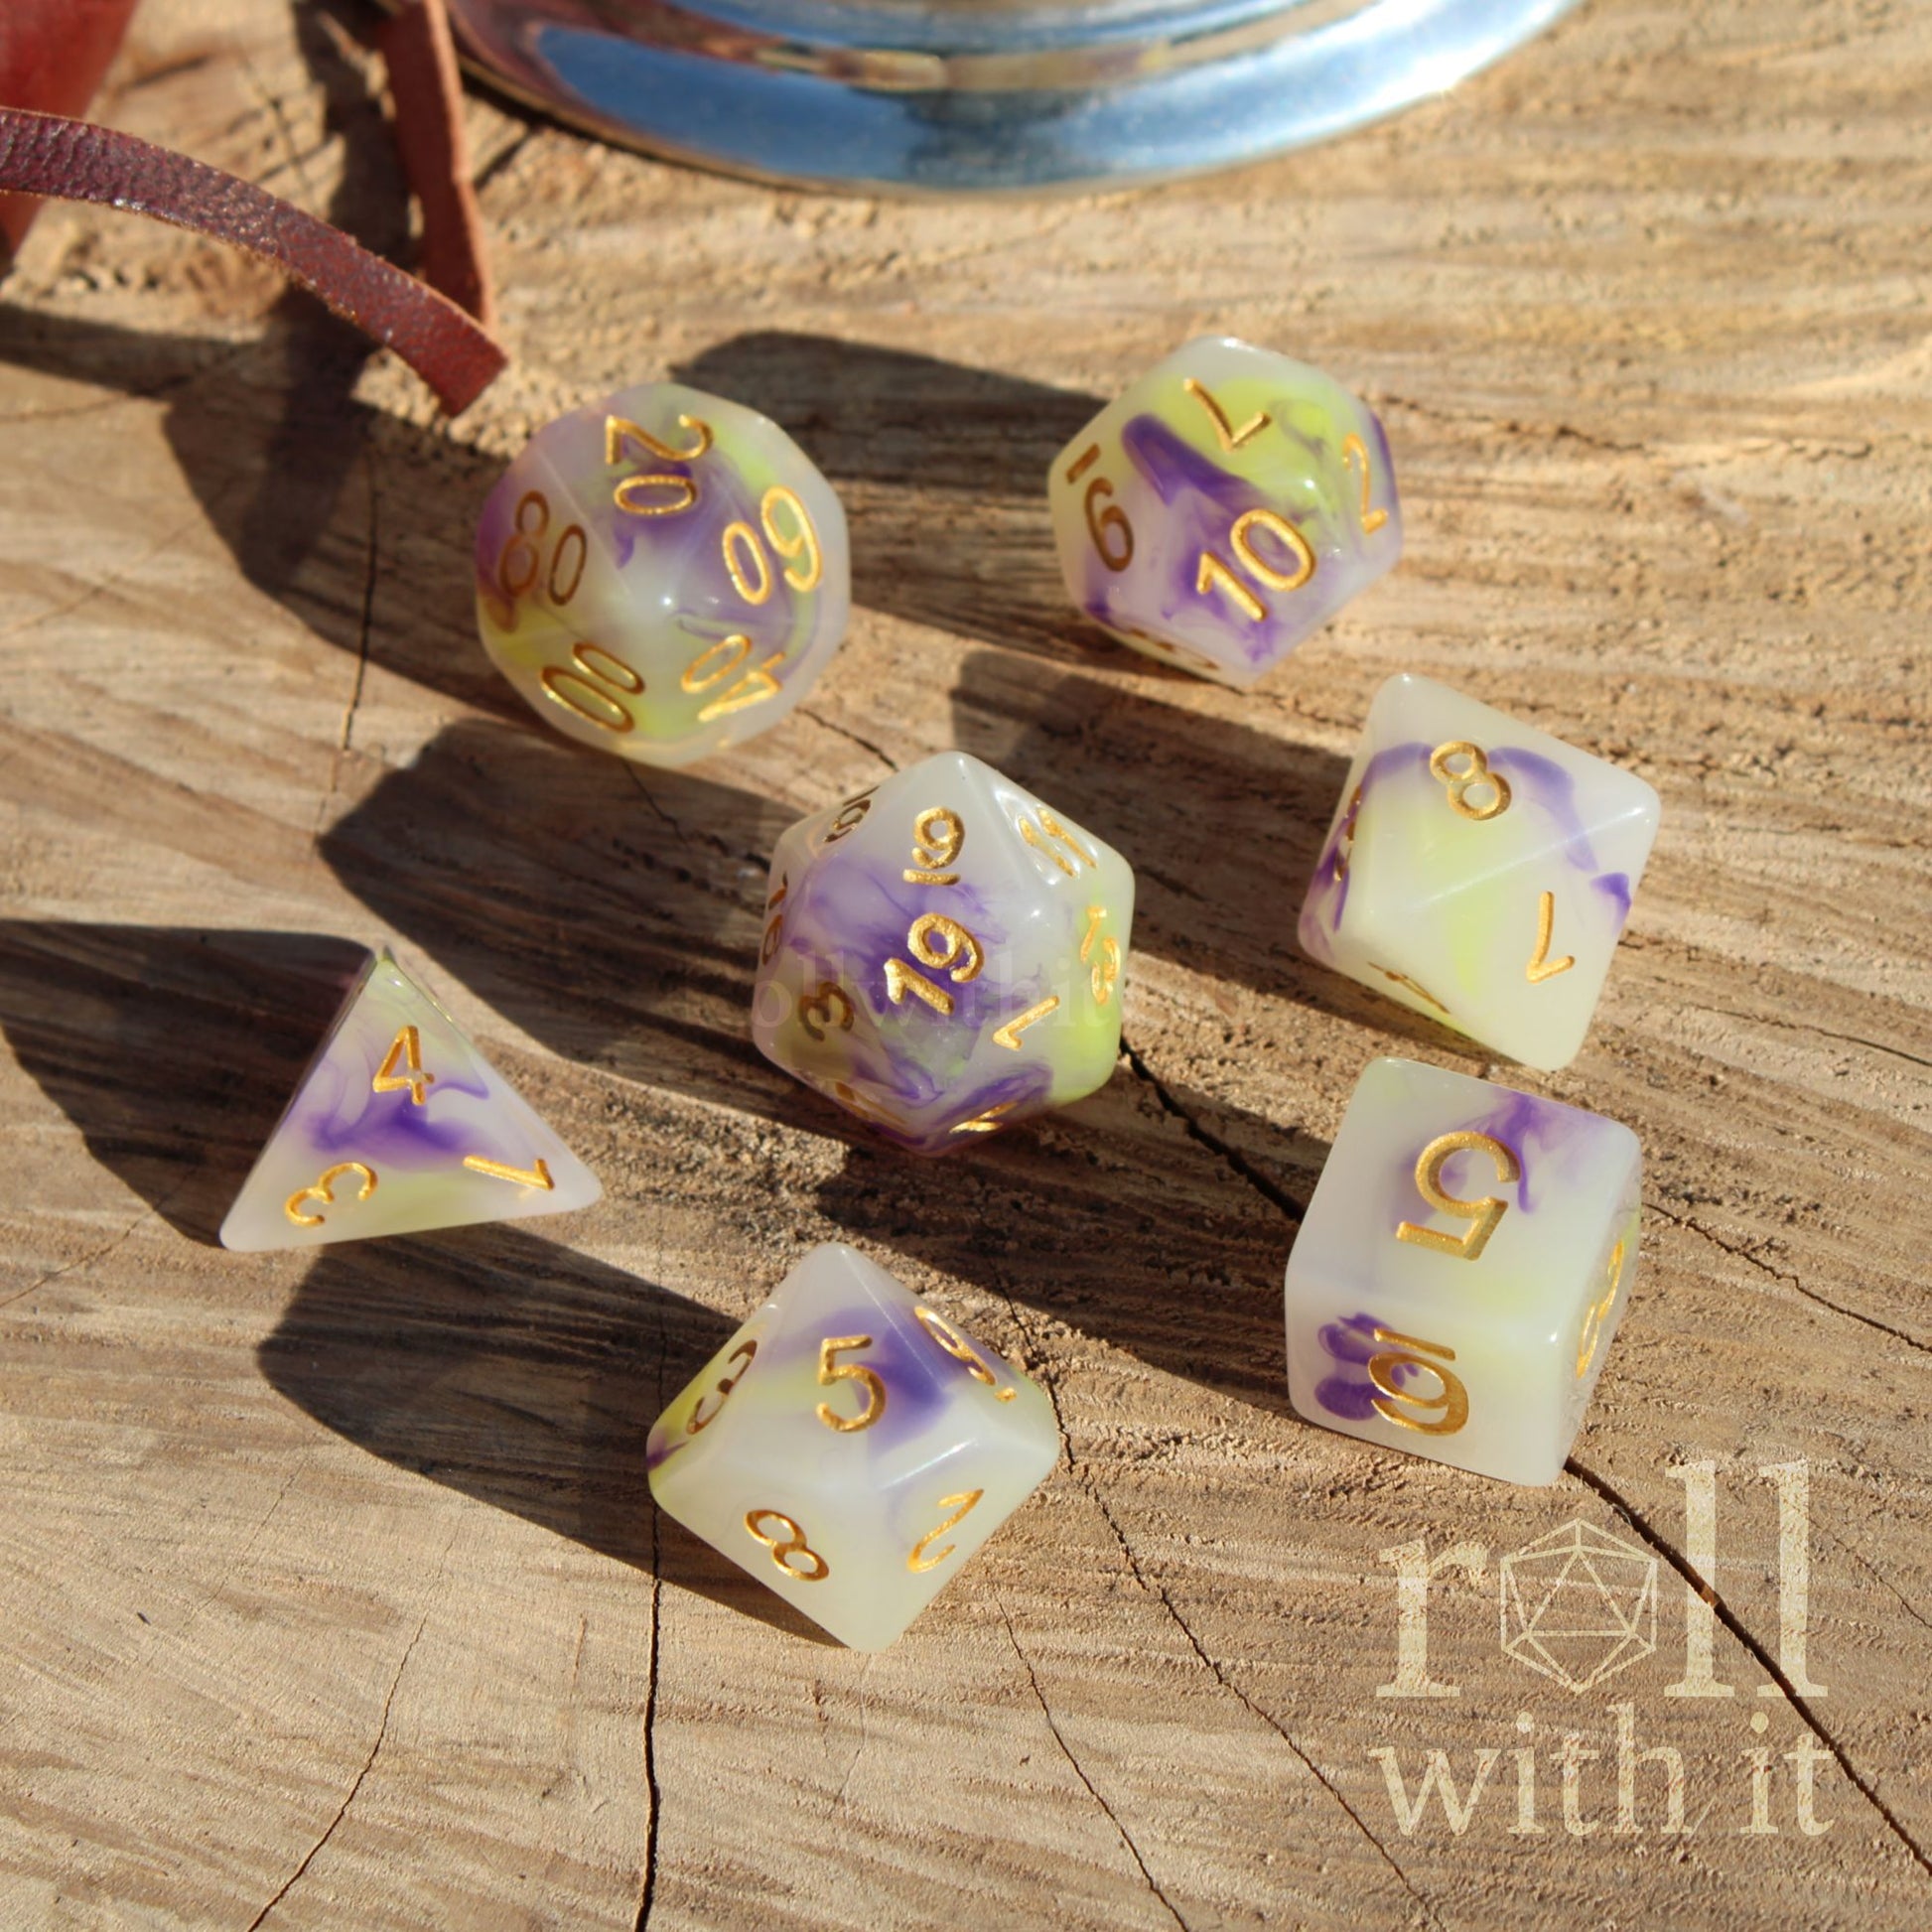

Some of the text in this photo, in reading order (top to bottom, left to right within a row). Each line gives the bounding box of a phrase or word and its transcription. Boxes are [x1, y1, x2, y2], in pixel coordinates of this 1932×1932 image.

[1196, 508, 1316, 622] 10
[1430, 741, 1512, 821] 8
[884, 912, 985, 1016] 19
[373, 1025, 435, 1106] 4
[285, 1162, 378, 1228] 3
[1396, 1131, 1521, 1261] 5
[816, 1334, 887, 1434] 5
[744, 1509, 830, 1582] 8
